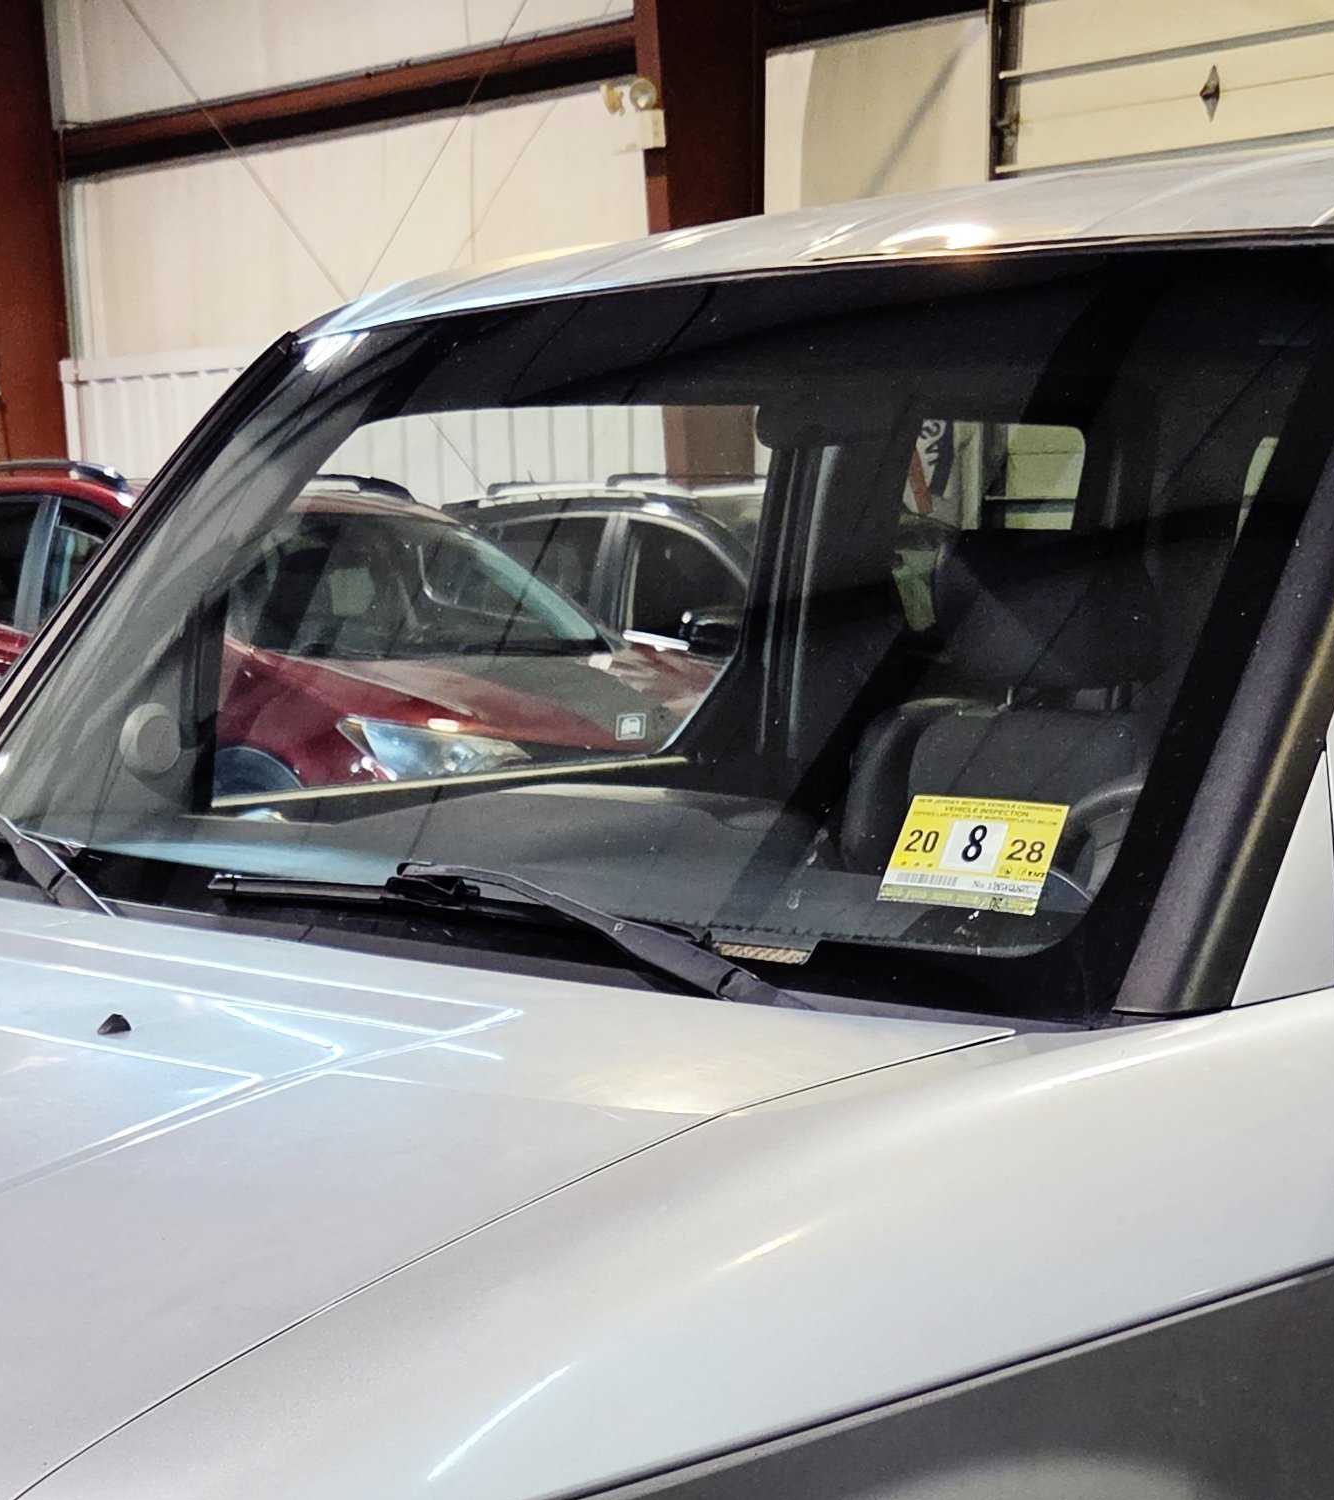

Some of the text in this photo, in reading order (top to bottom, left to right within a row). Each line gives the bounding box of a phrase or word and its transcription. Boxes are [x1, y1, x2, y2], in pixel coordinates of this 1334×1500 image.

[979, 807, 1029, 817] INSPECTION
[904, 824, 1046, 863] 20 8 28
